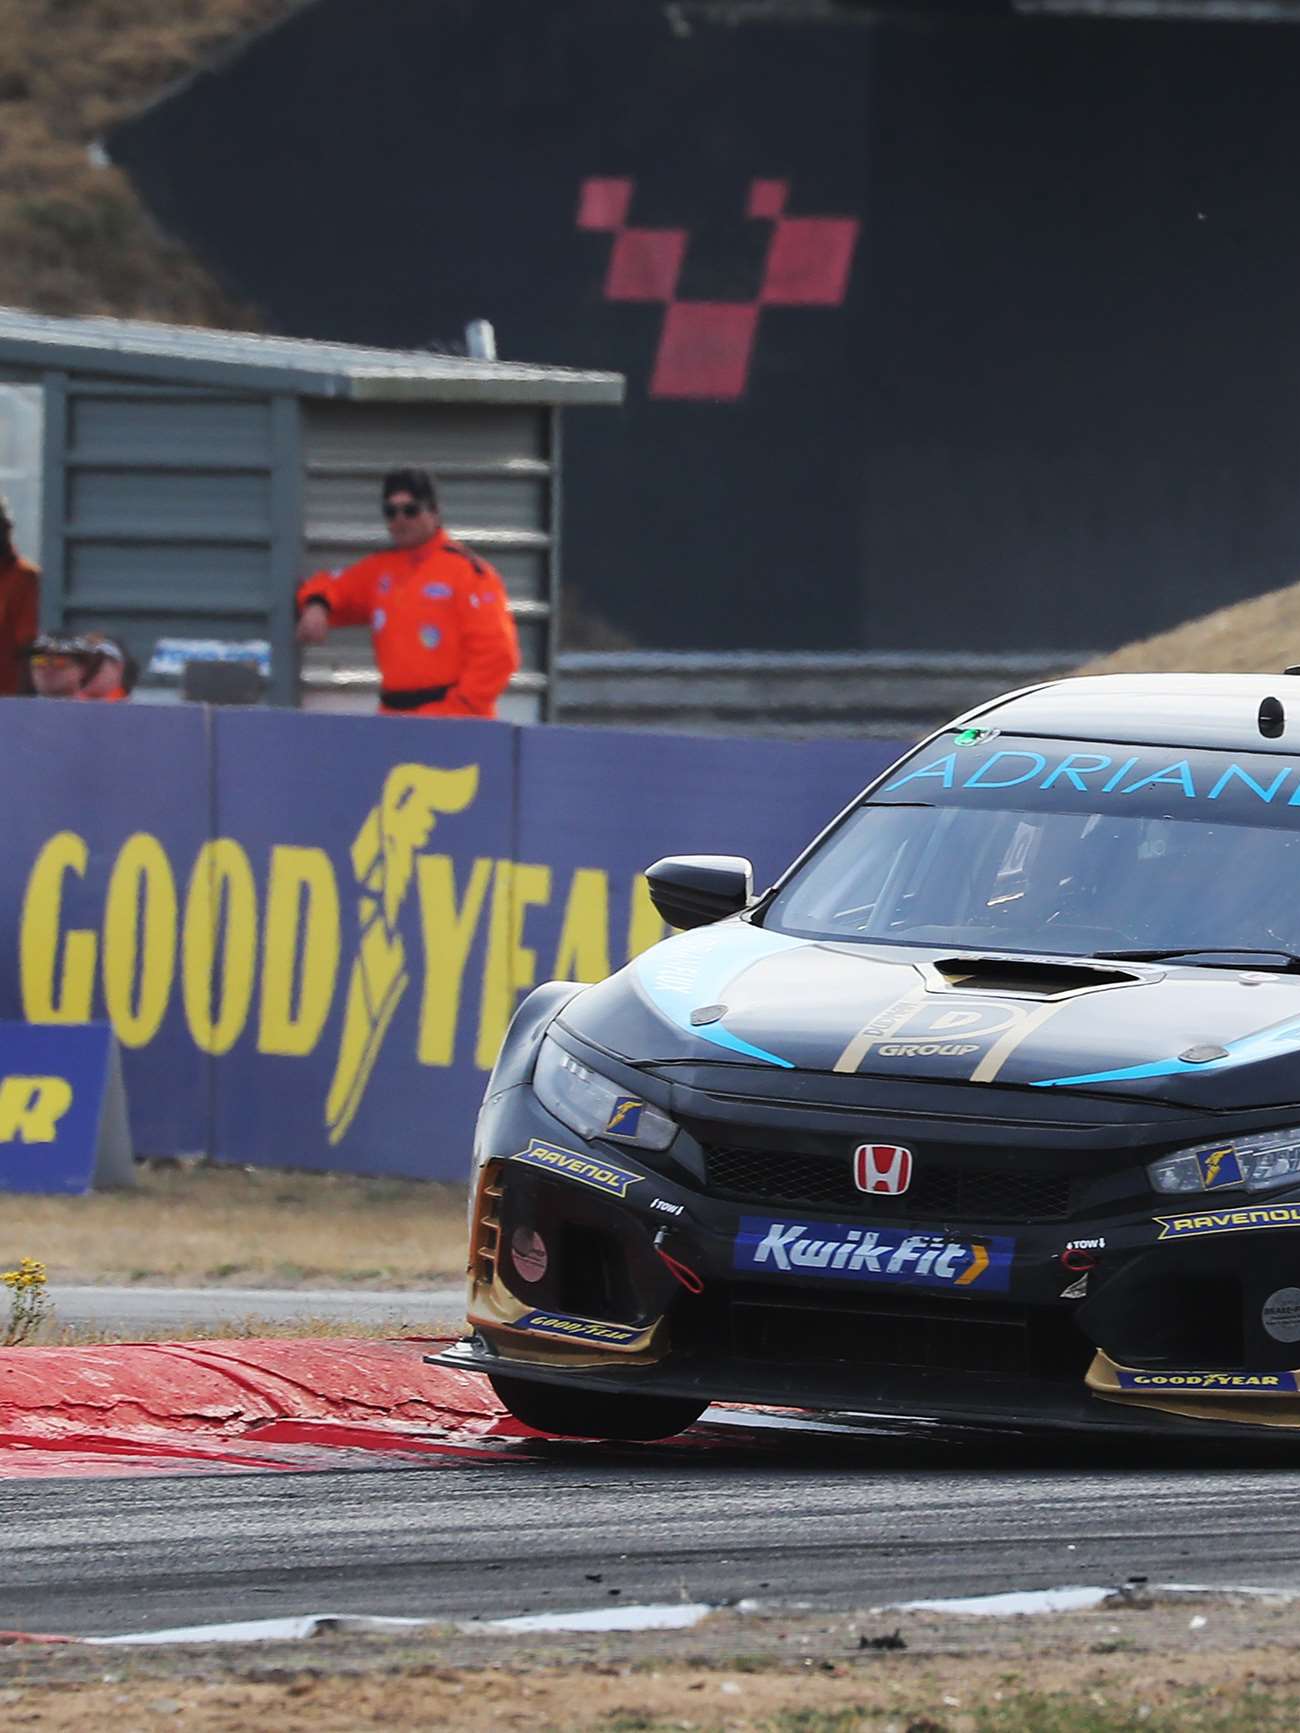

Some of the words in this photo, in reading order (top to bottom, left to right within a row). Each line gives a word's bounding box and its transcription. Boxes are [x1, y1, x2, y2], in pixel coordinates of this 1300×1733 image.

[878, 1044, 980, 1057] GROUP
[0, 1076, 73, 1144] R
[528, 1147, 621, 1188] RAVENOL
[656, 1201, 679, 1214] TOW
[1073, 1238, 1098, 1249] TOW
[530, 1314, 634, 1342] GOODYEAR
[1134, 1372, 1280, 1388] GOODYEAR
